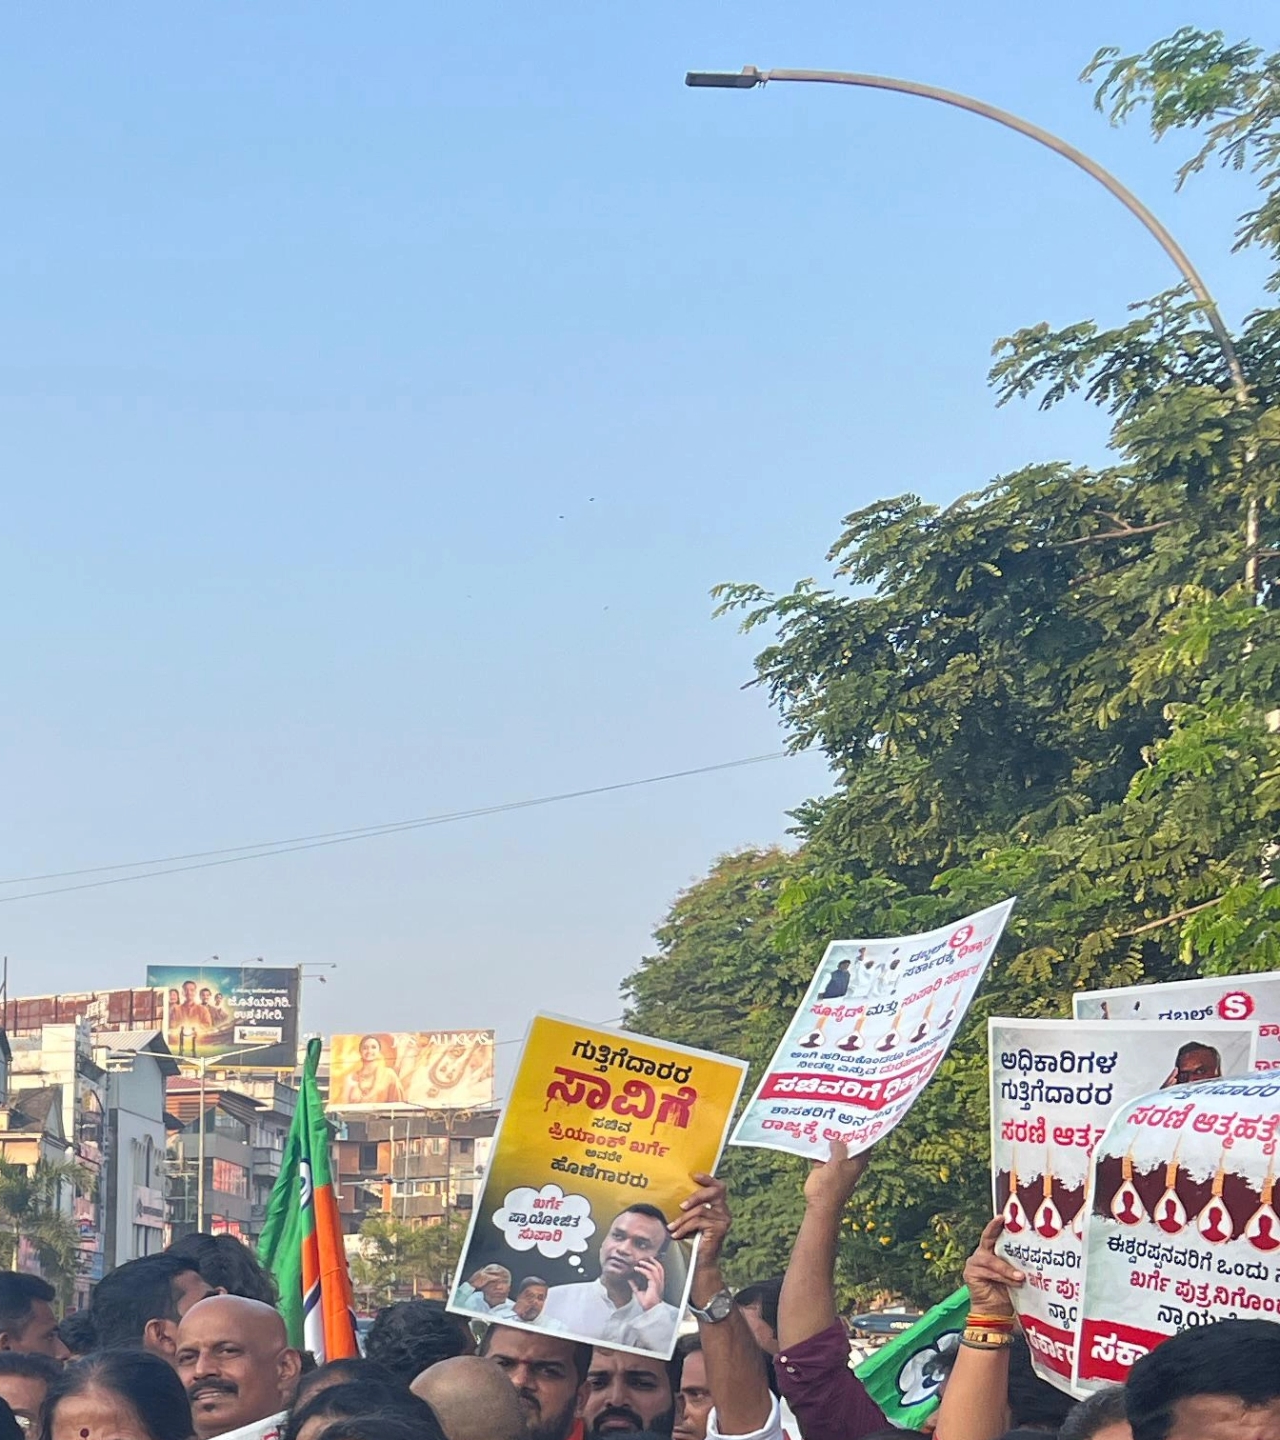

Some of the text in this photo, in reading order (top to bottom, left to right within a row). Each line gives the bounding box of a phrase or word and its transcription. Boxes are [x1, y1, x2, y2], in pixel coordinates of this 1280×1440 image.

[572, 1039, 692, 1084] ಗುತ್ತಿಗೆದಾರರ
[1001, 1049, 1118, 1077] ಅಧಿಕಾರಿಗಳ
[543, 1066, 697, 1134] ಸಾವಿಗೆ
[1001, 1080, 1113, 1111] ಗುತ್ತಿಗೆದಾರರ
[592, 1116, 631, 1134] ಸಚಿವ
[1001, 1116, 1045, 1145] ಸರಣಿ
[1127, 1104, 1193, 1130] ಸರಣಿ
[630, 1140, 670, 1158] ಖರ್ಗೆ
[1218, 1256, 1269, 1282] ಒಂದು
